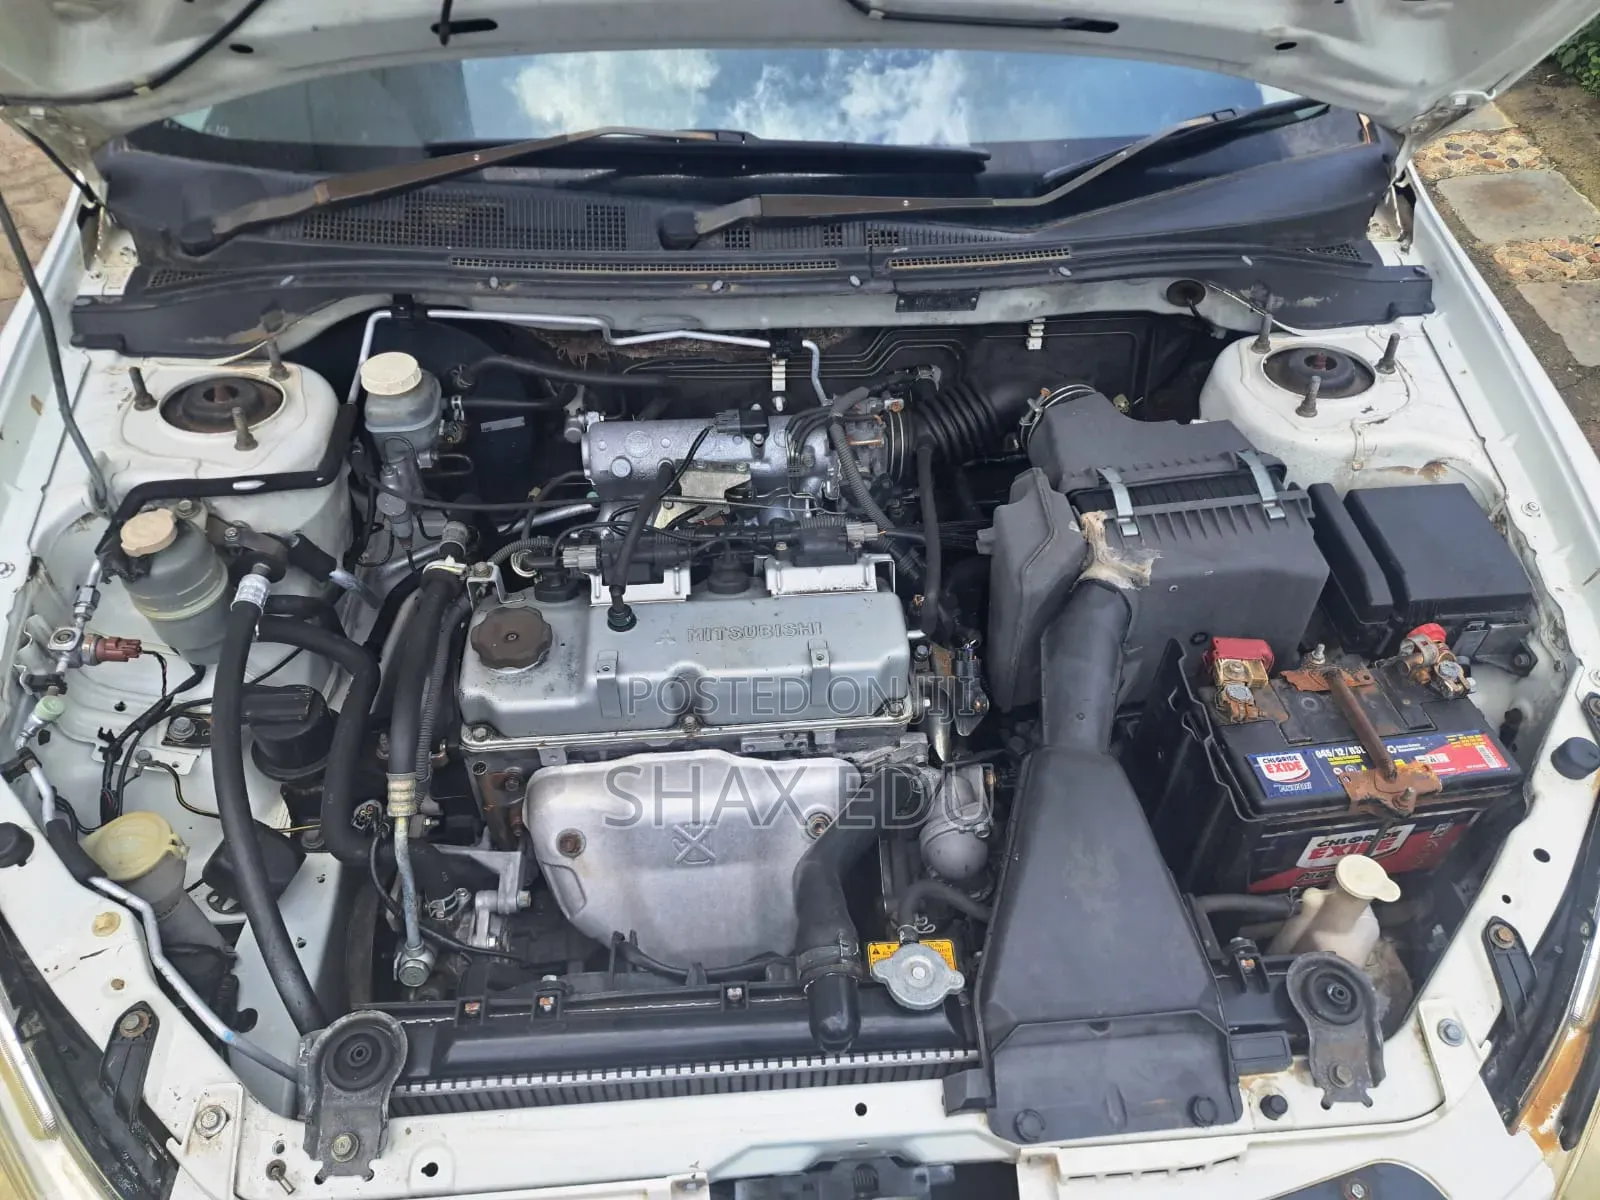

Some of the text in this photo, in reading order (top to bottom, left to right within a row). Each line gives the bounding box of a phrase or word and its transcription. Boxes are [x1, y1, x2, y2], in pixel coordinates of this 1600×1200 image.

[687, 621, 823, 643] MITSUBISHI
[1262, 755, 1299, 764] CHLORIDE
[1264, 761, 1304, 774] EXIDE
[1316, 830, 1402, 848] CHLORDE
